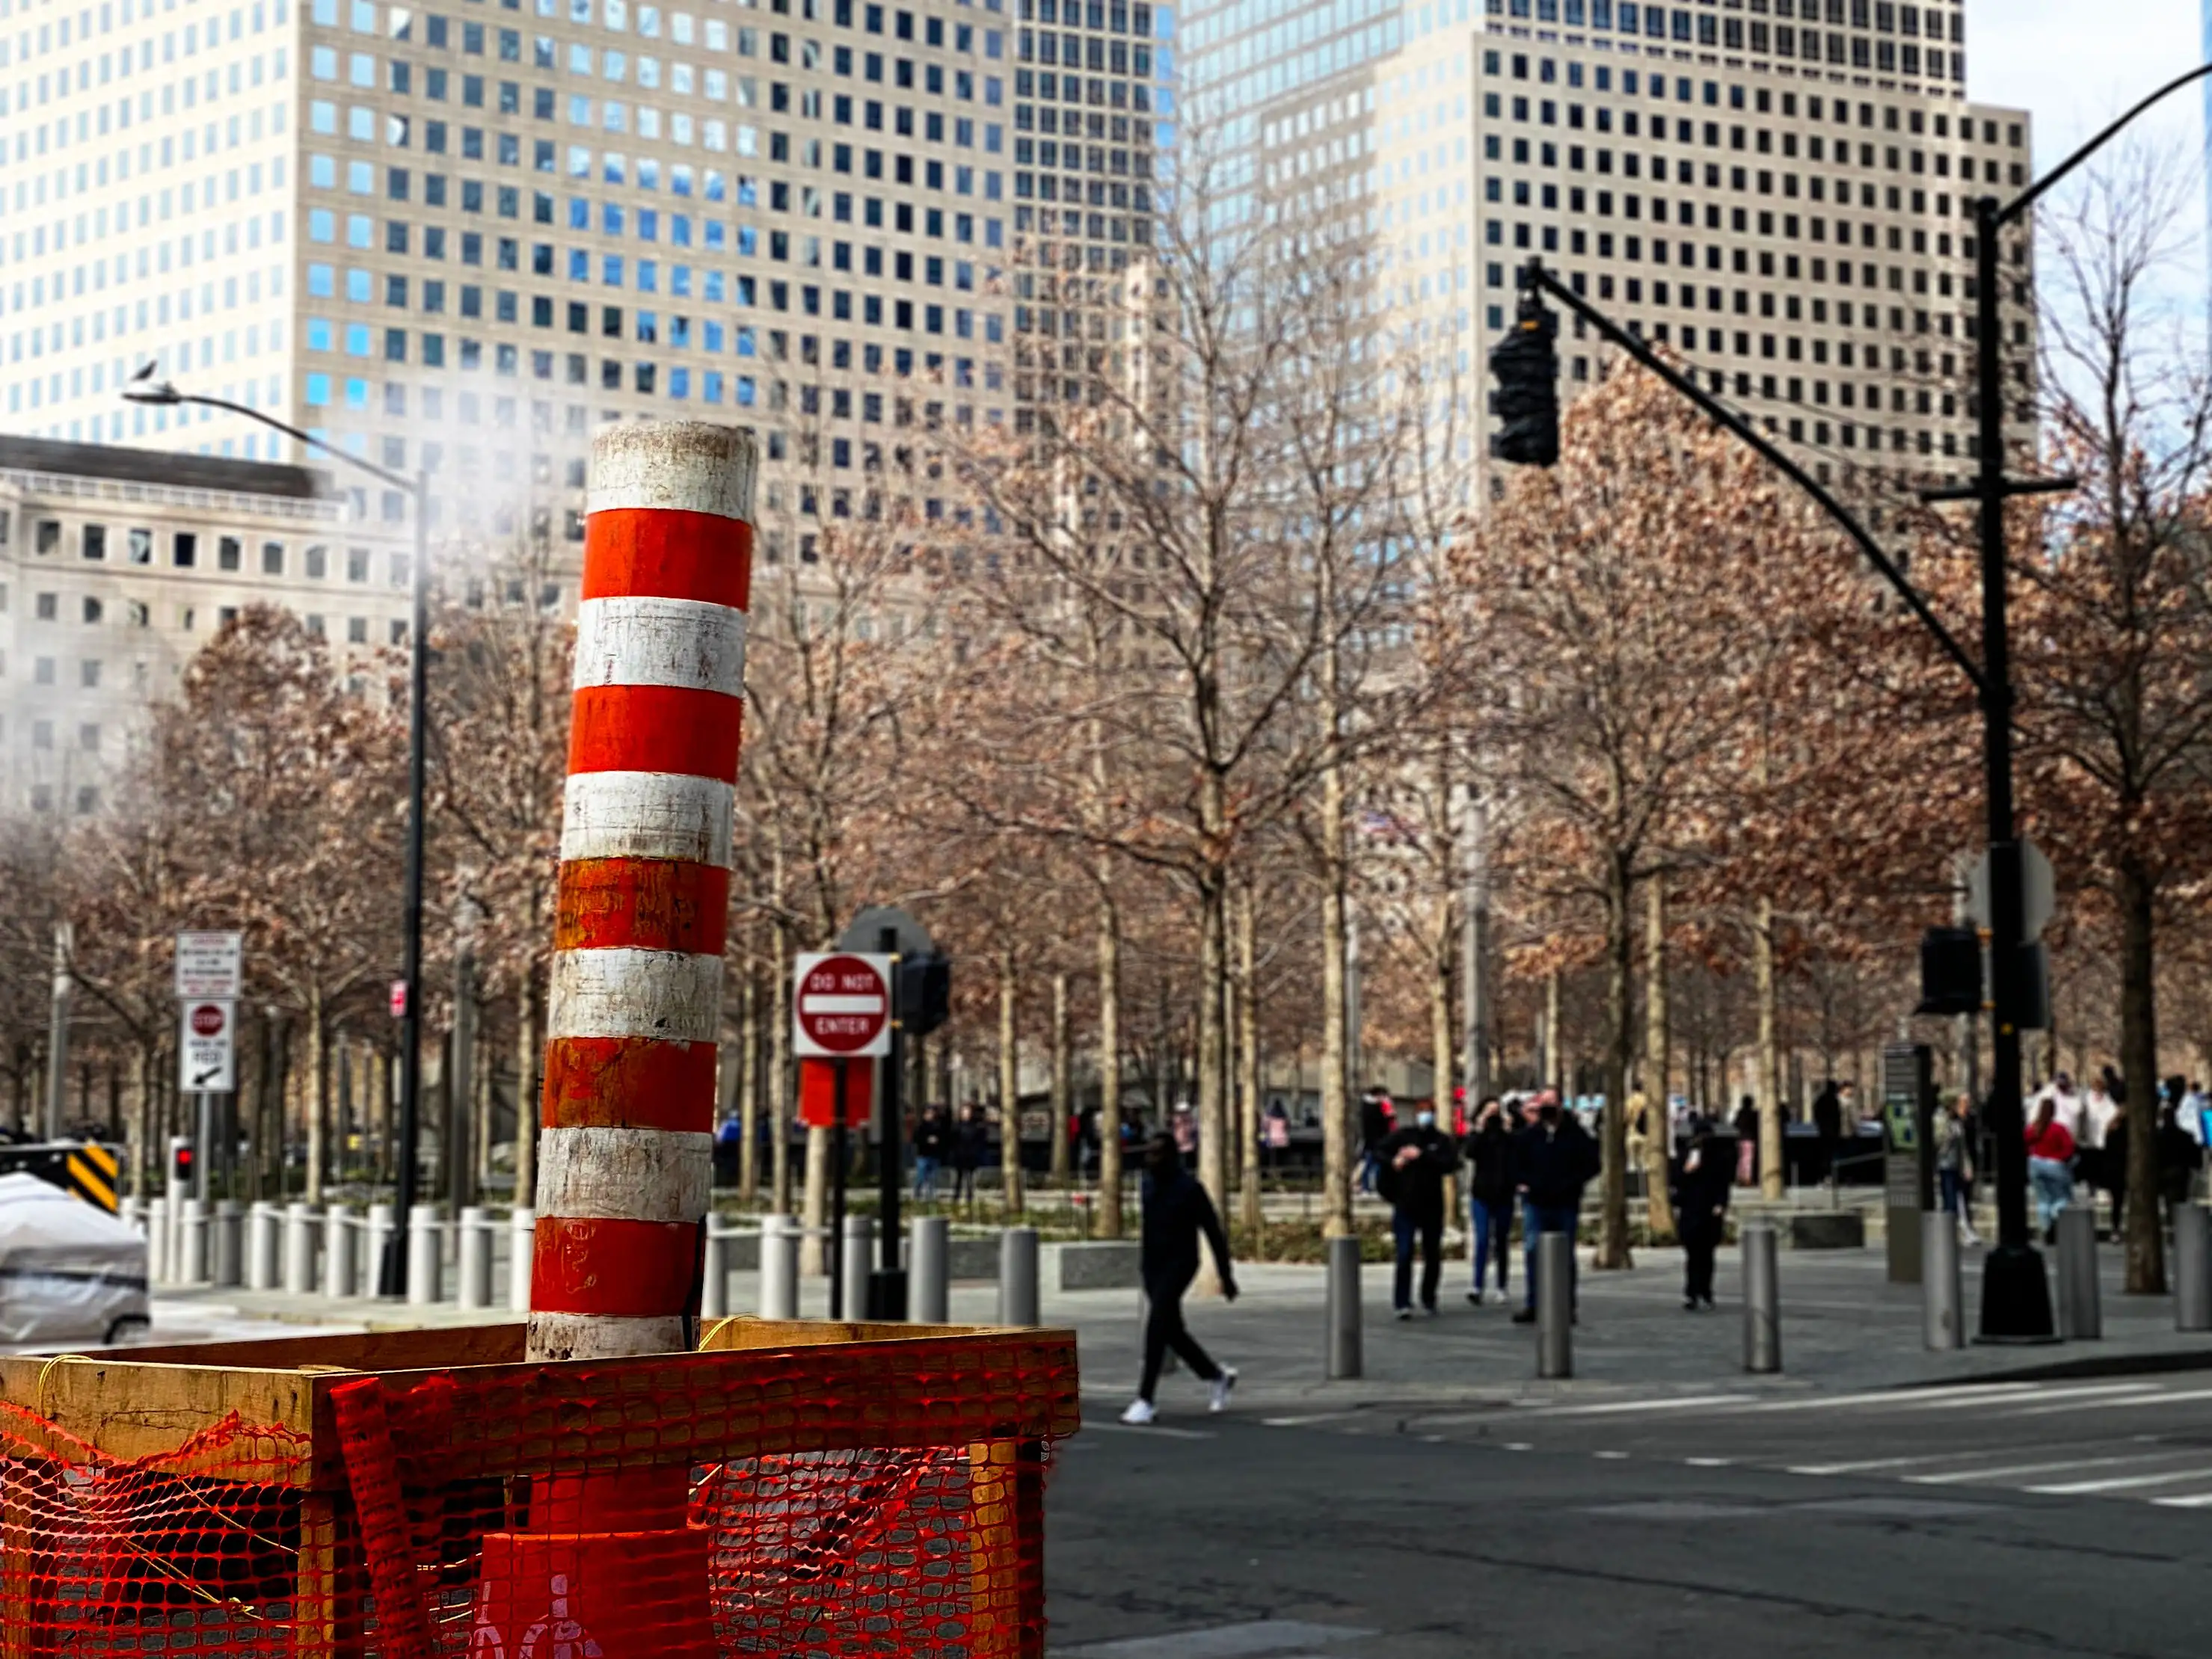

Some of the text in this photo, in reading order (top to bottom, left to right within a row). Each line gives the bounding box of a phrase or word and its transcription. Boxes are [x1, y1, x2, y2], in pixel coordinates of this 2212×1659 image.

[810, 973, 875, 991] DO NOT
[194, 1015, 222, 1027] STOP
[814, 1018, 869, 1035] ENTER
